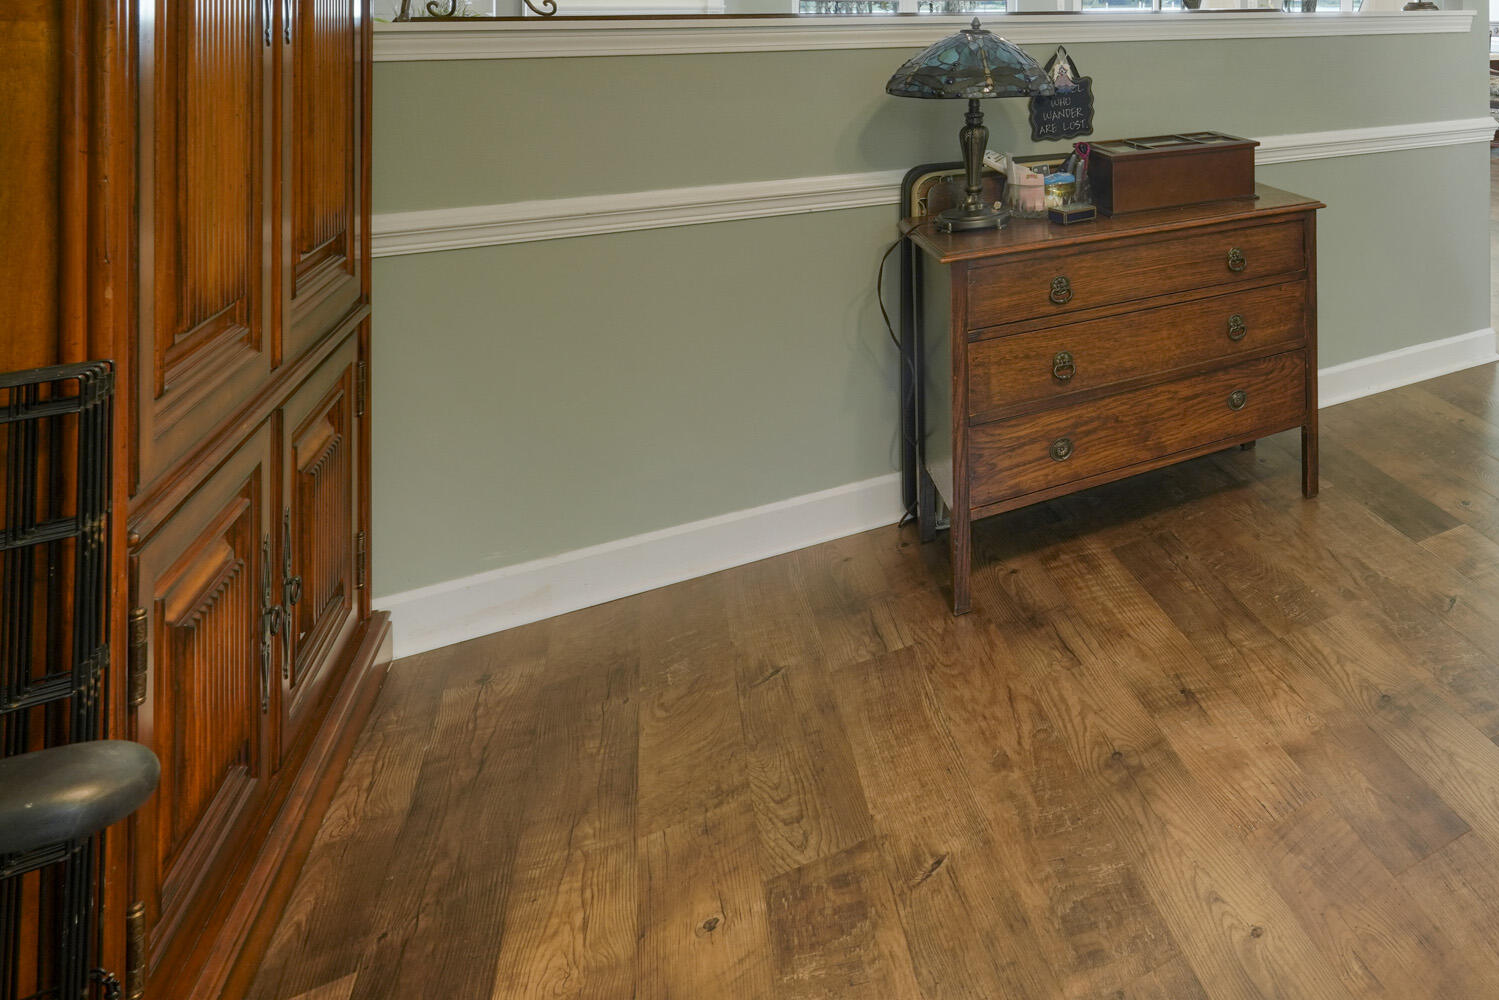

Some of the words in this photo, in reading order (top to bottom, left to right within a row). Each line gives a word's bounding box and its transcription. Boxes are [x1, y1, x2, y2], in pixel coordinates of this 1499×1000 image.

[1051, 97, 1071, 107] WHO
[1043, 108, 1084, 120] WANDER
[1040, 124, 1056, 134] ARE
